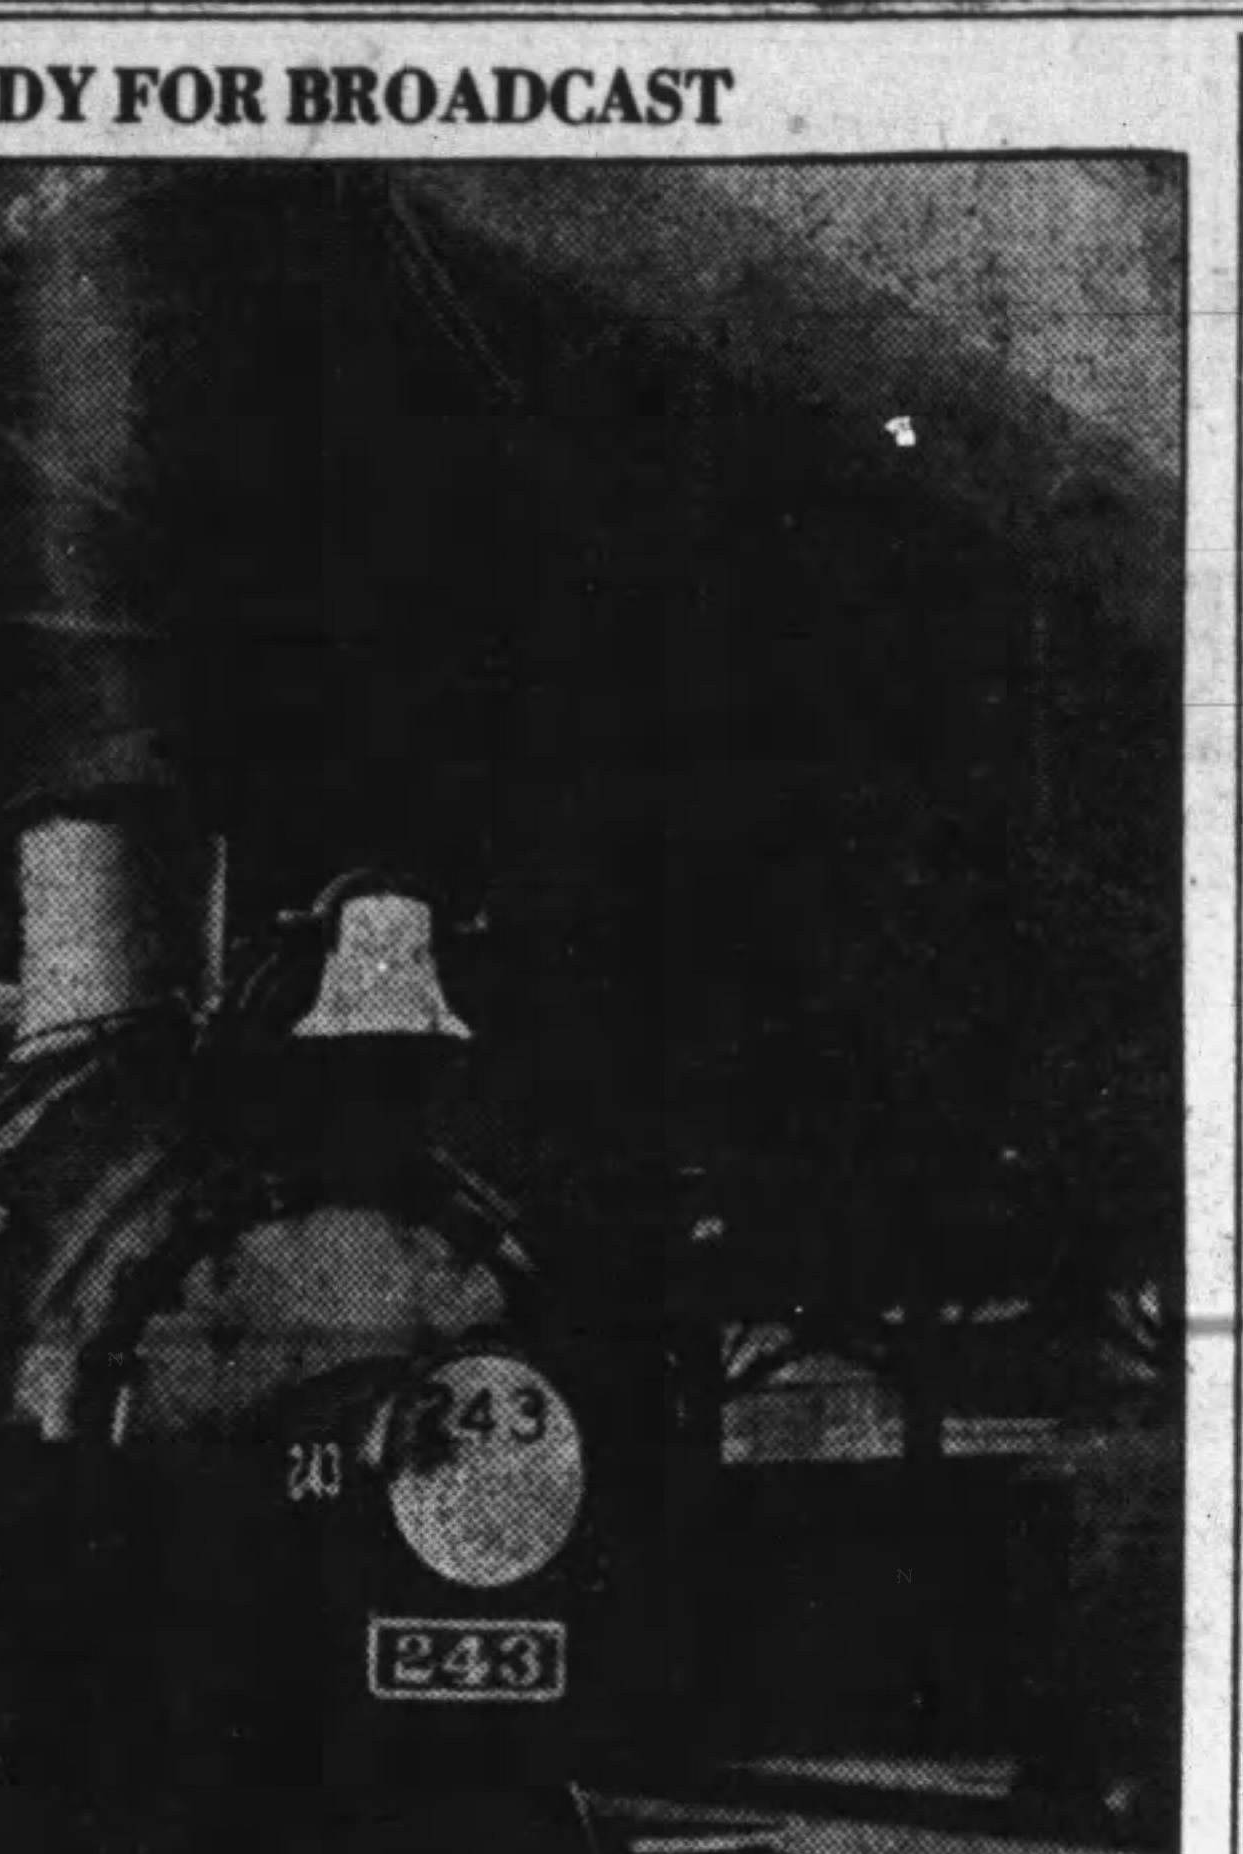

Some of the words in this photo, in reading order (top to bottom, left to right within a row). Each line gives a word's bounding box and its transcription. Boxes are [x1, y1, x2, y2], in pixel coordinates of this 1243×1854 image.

[114, 67, 266, 126] FOR
[286, 66, 734, 125] BROADCAST
[393, 1634, 544, 1685] 243
